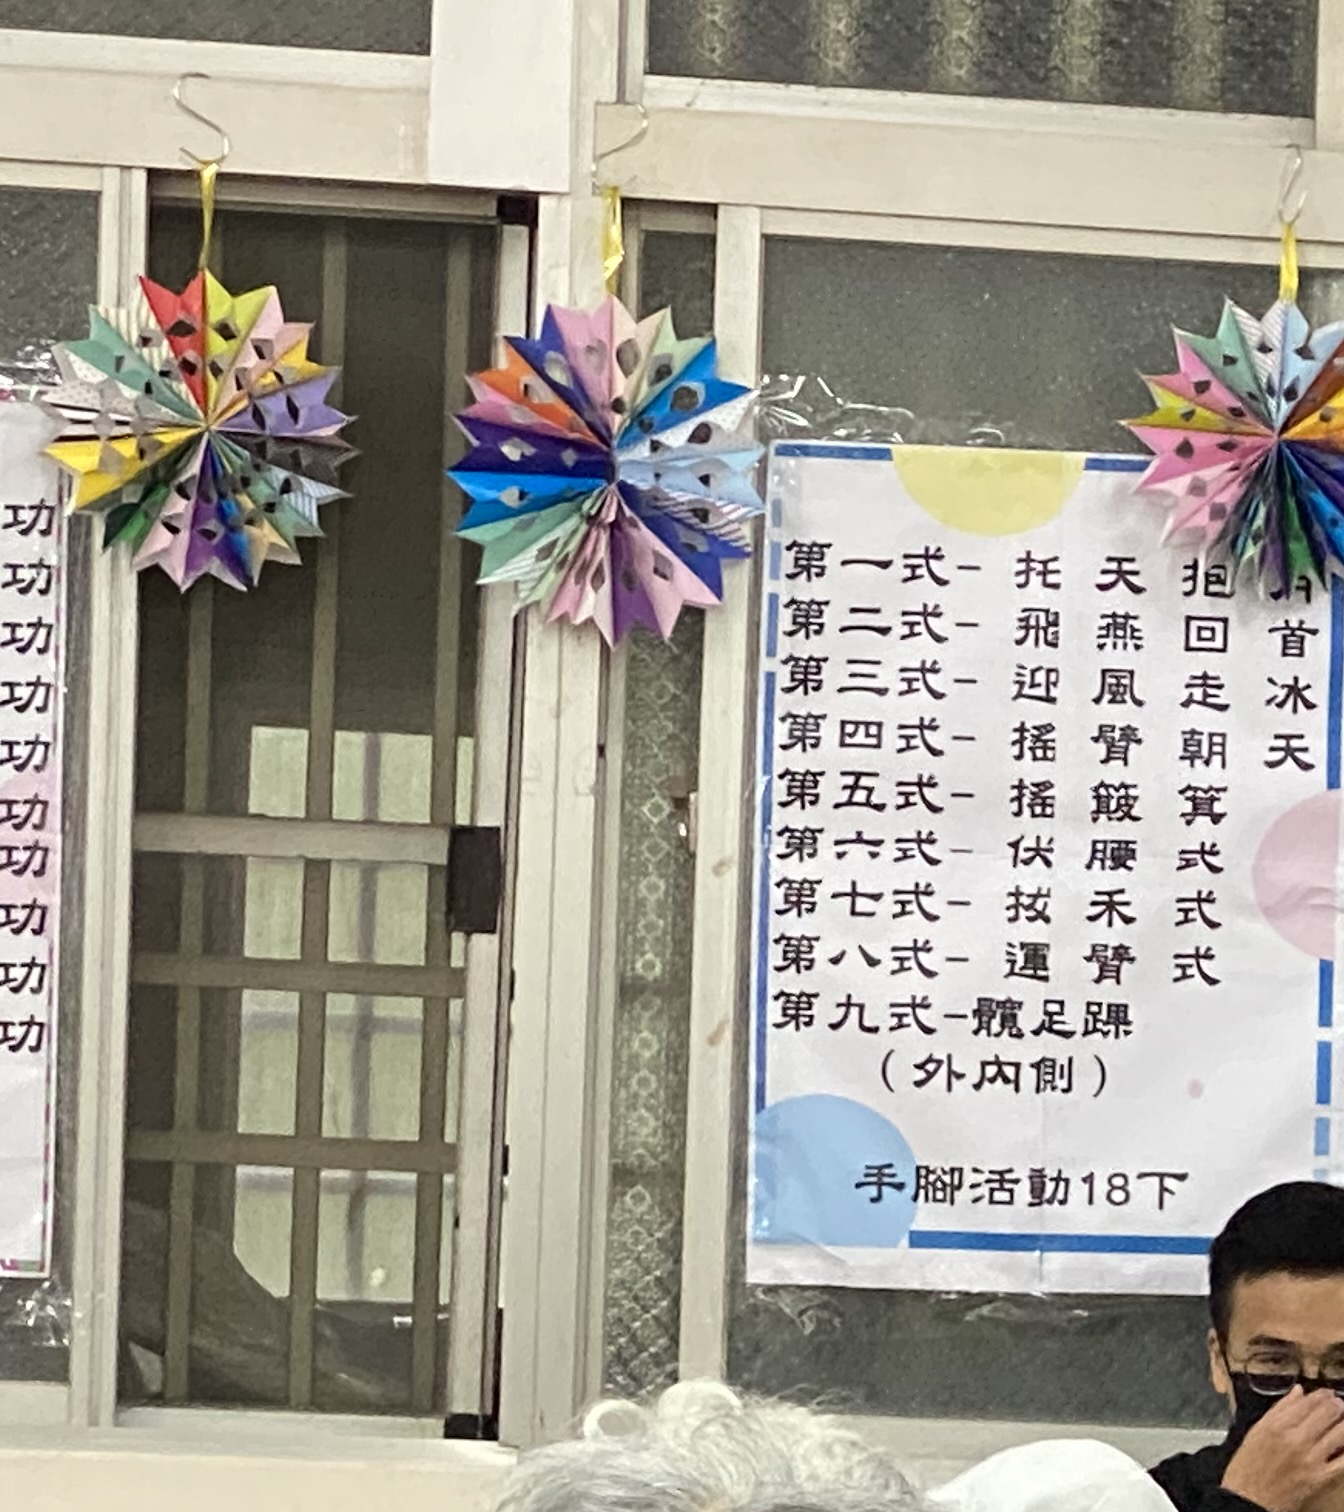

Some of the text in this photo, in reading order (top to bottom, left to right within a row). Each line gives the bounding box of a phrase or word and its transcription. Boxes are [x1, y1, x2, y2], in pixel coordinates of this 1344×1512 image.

[1, 498, 55, 538] 功
[0, 557, 53, 597] 功
[0, 615, 54, 656] 功
[0, 674, 53, 714] 功
[0, 734, 51, 774] 功
[0, 793, 49, 832] 功
[0, 839, 49, 879] 功
[0, 897, 48, 937] 功
[853, 1162, 1190, 1211] 手腳活動18下
